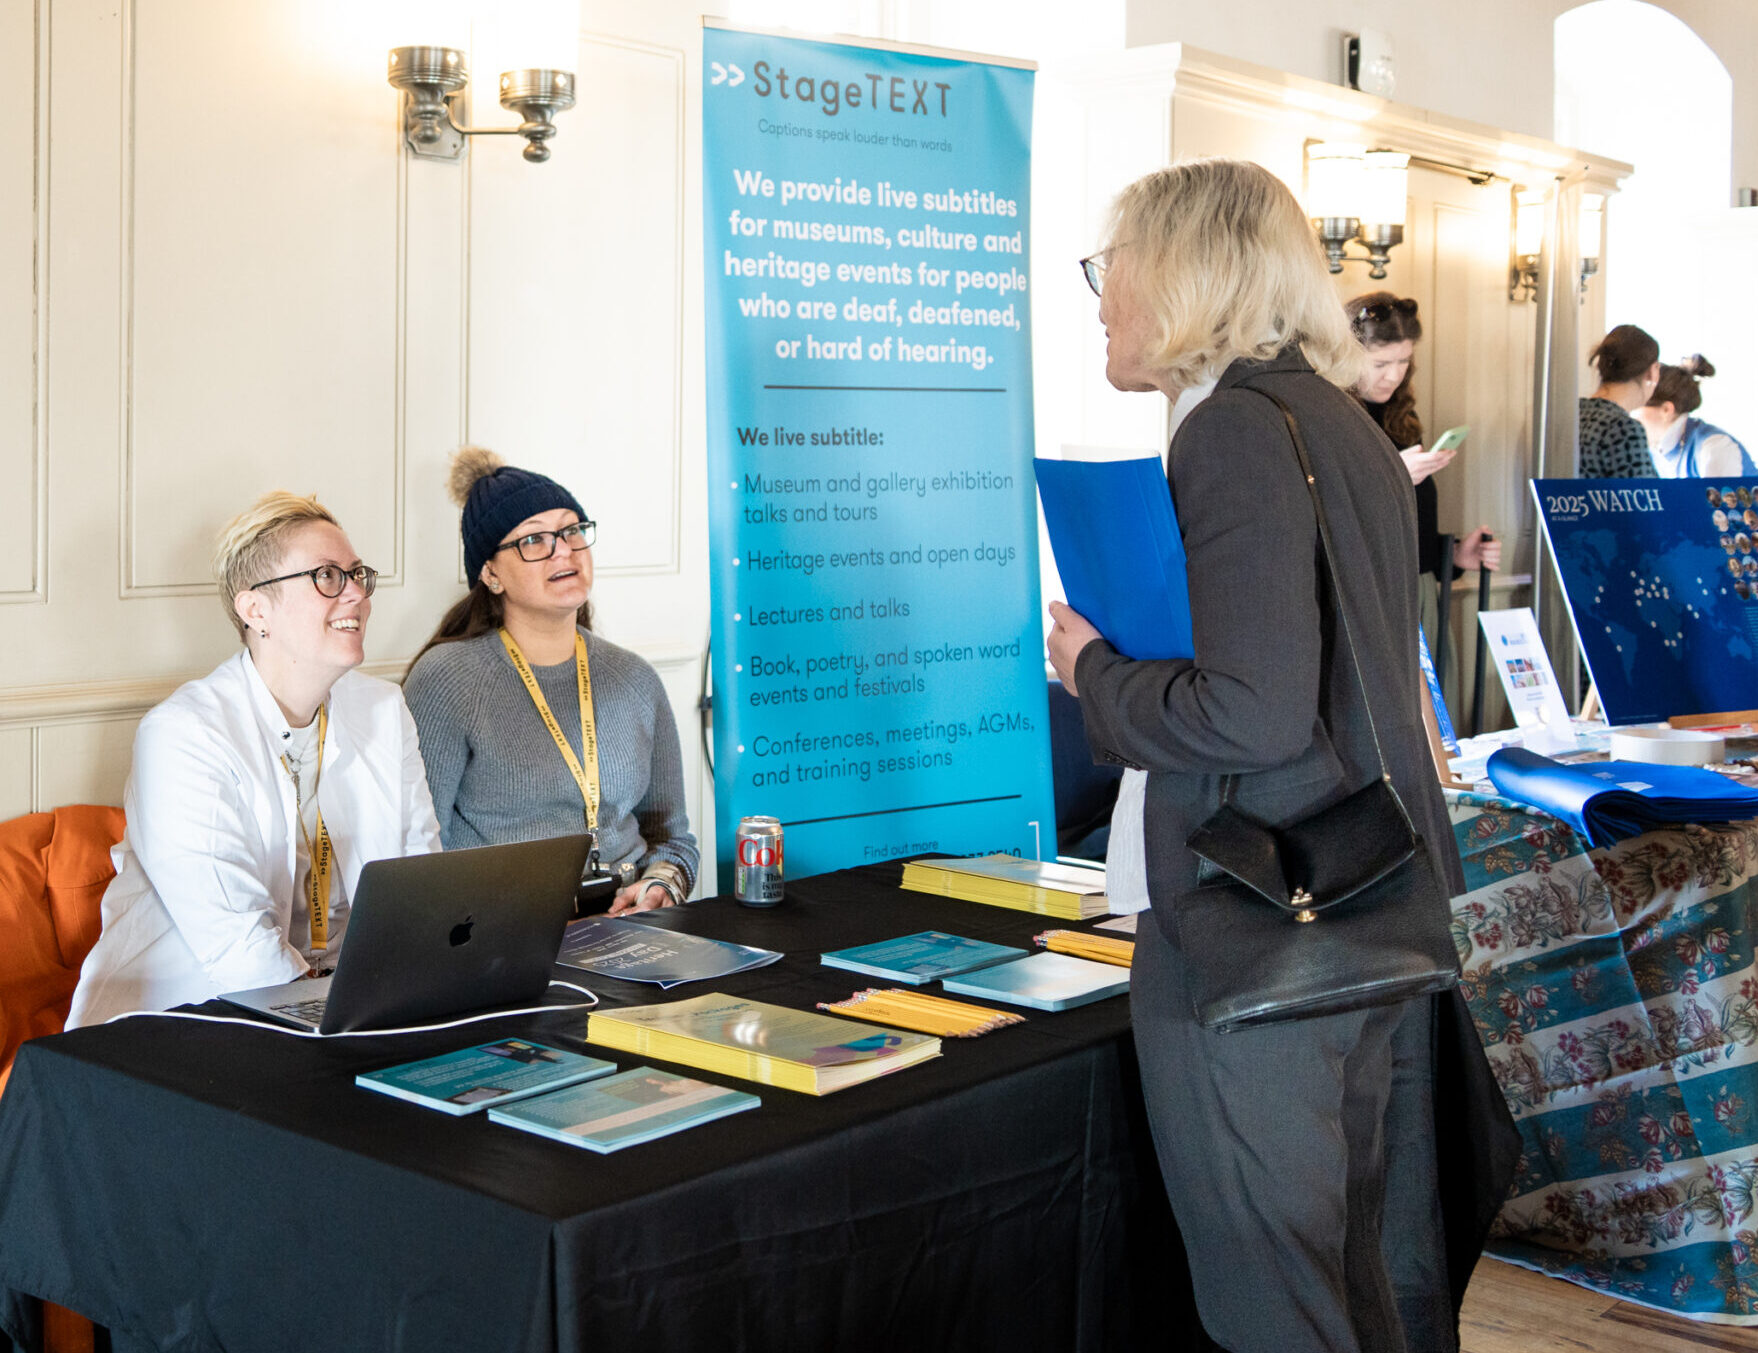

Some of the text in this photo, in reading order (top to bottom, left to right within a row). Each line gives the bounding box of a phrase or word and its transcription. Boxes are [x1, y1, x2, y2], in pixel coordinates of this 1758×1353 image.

[753, 60, 952, 117] StageTEXT
[758, 118, 953, 153] Captions speak louder than words
[733, 169, 1017, 217] We provide live subtitles
[729, 209, 1022, 254] for museums, culture and
[724, 250, 1026, 295] heritage events for people
[738, 292, 1020, 331] who are deaf, deafened,
[776, 335, 994, 370] or hard of hearing.
[737, 427, 884, 446] We live subtitle:
[744, 471, 1013, 498] Museum and gallery exhibition
[744, 502, 878, 524] talks and tours
[1546, 489, 1664, 517] 2025 WATCH
[748, 543, 1016, 576] Heritage events and open days
[750, 598, 910, 625] Lectures and talks
[751, 638, 1020, 678] Book, poetry, and spoken word
[750, 674, 925, 707] events and festivals
[753, 712, 1035, 758] Conferences, meetings, AGMs,
[753, 751, 953, 788] and training sessions
[864, 840, 939, 859] Find out more
